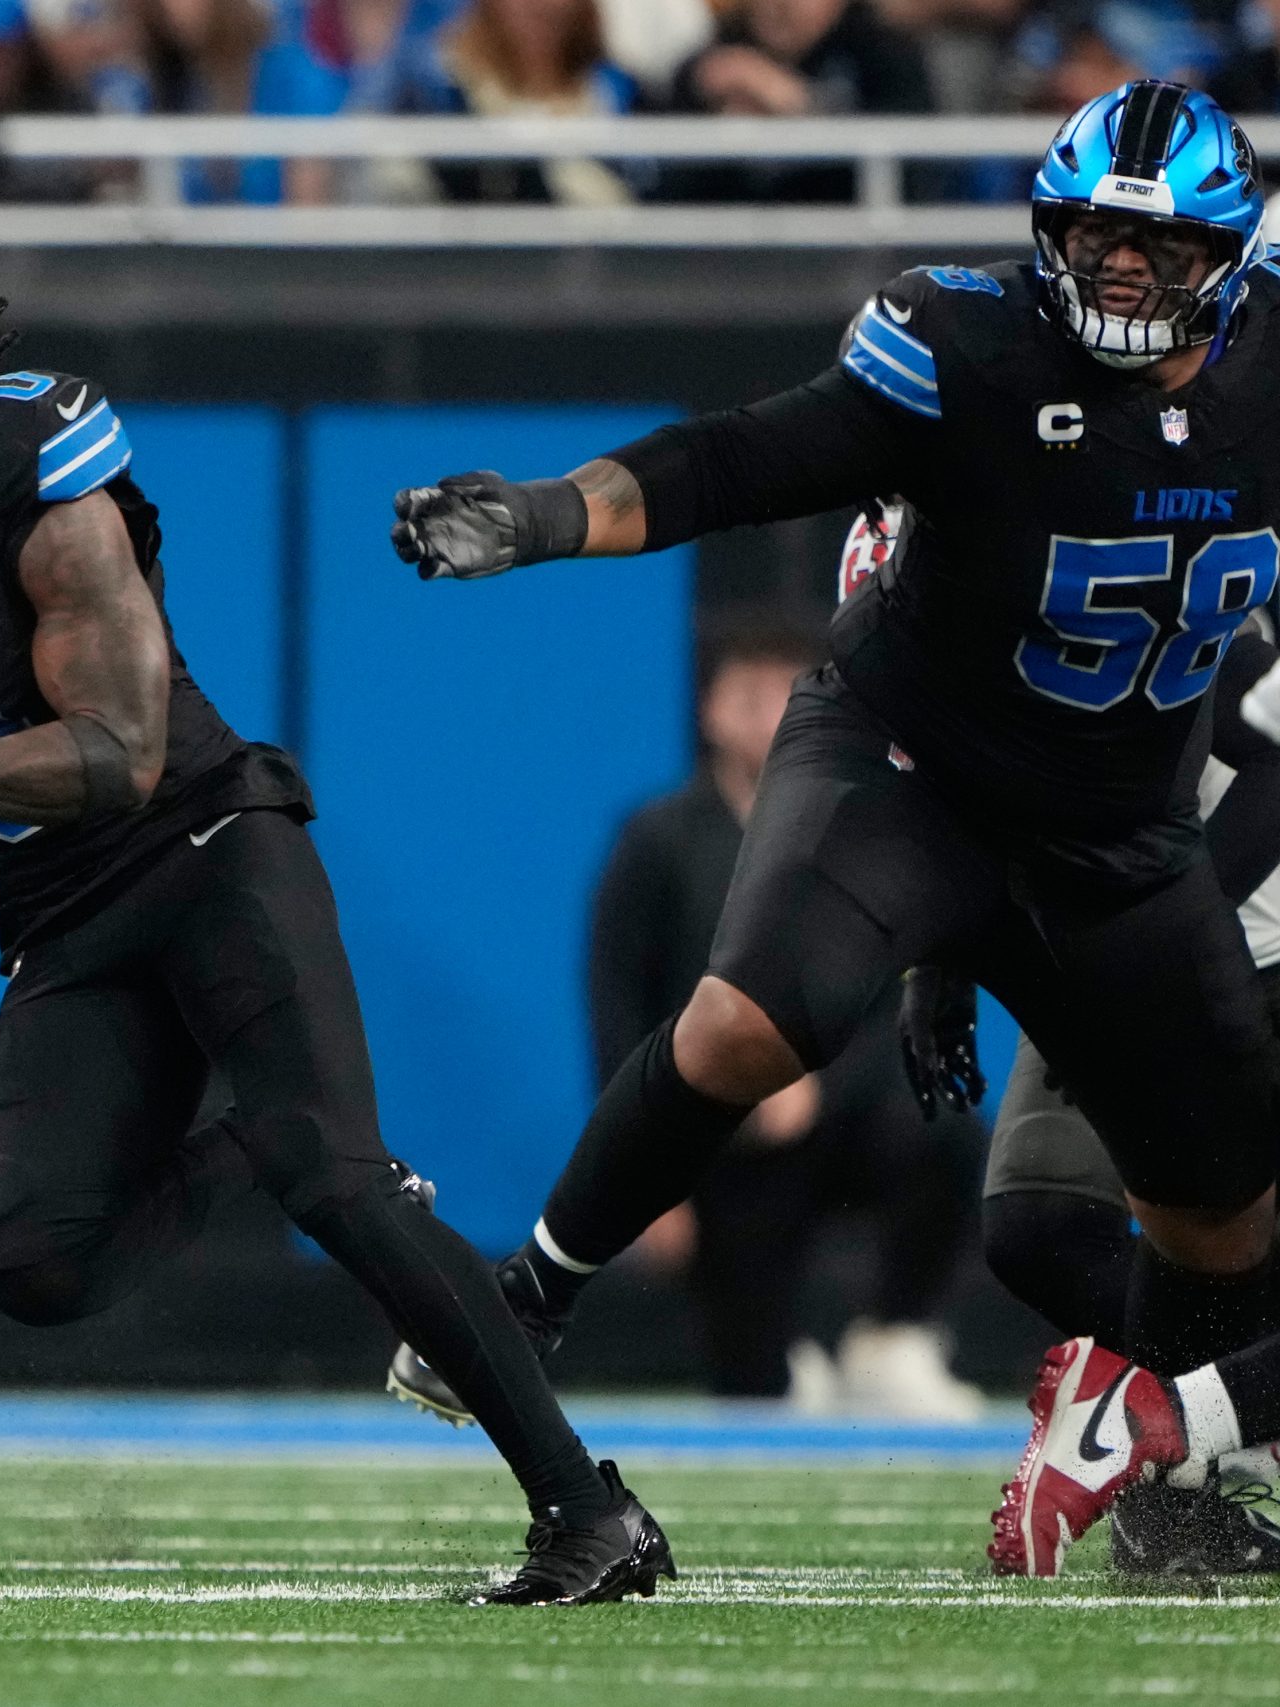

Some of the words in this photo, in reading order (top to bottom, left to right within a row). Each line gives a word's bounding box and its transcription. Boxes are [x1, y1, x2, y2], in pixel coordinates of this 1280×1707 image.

[1115, 181, 1155, 197] DETROIT
[1037, 403, 1084, 442] C
[1134, 487, 1239, 522] LIONS
[1014, 526, 1280, 711] 58
